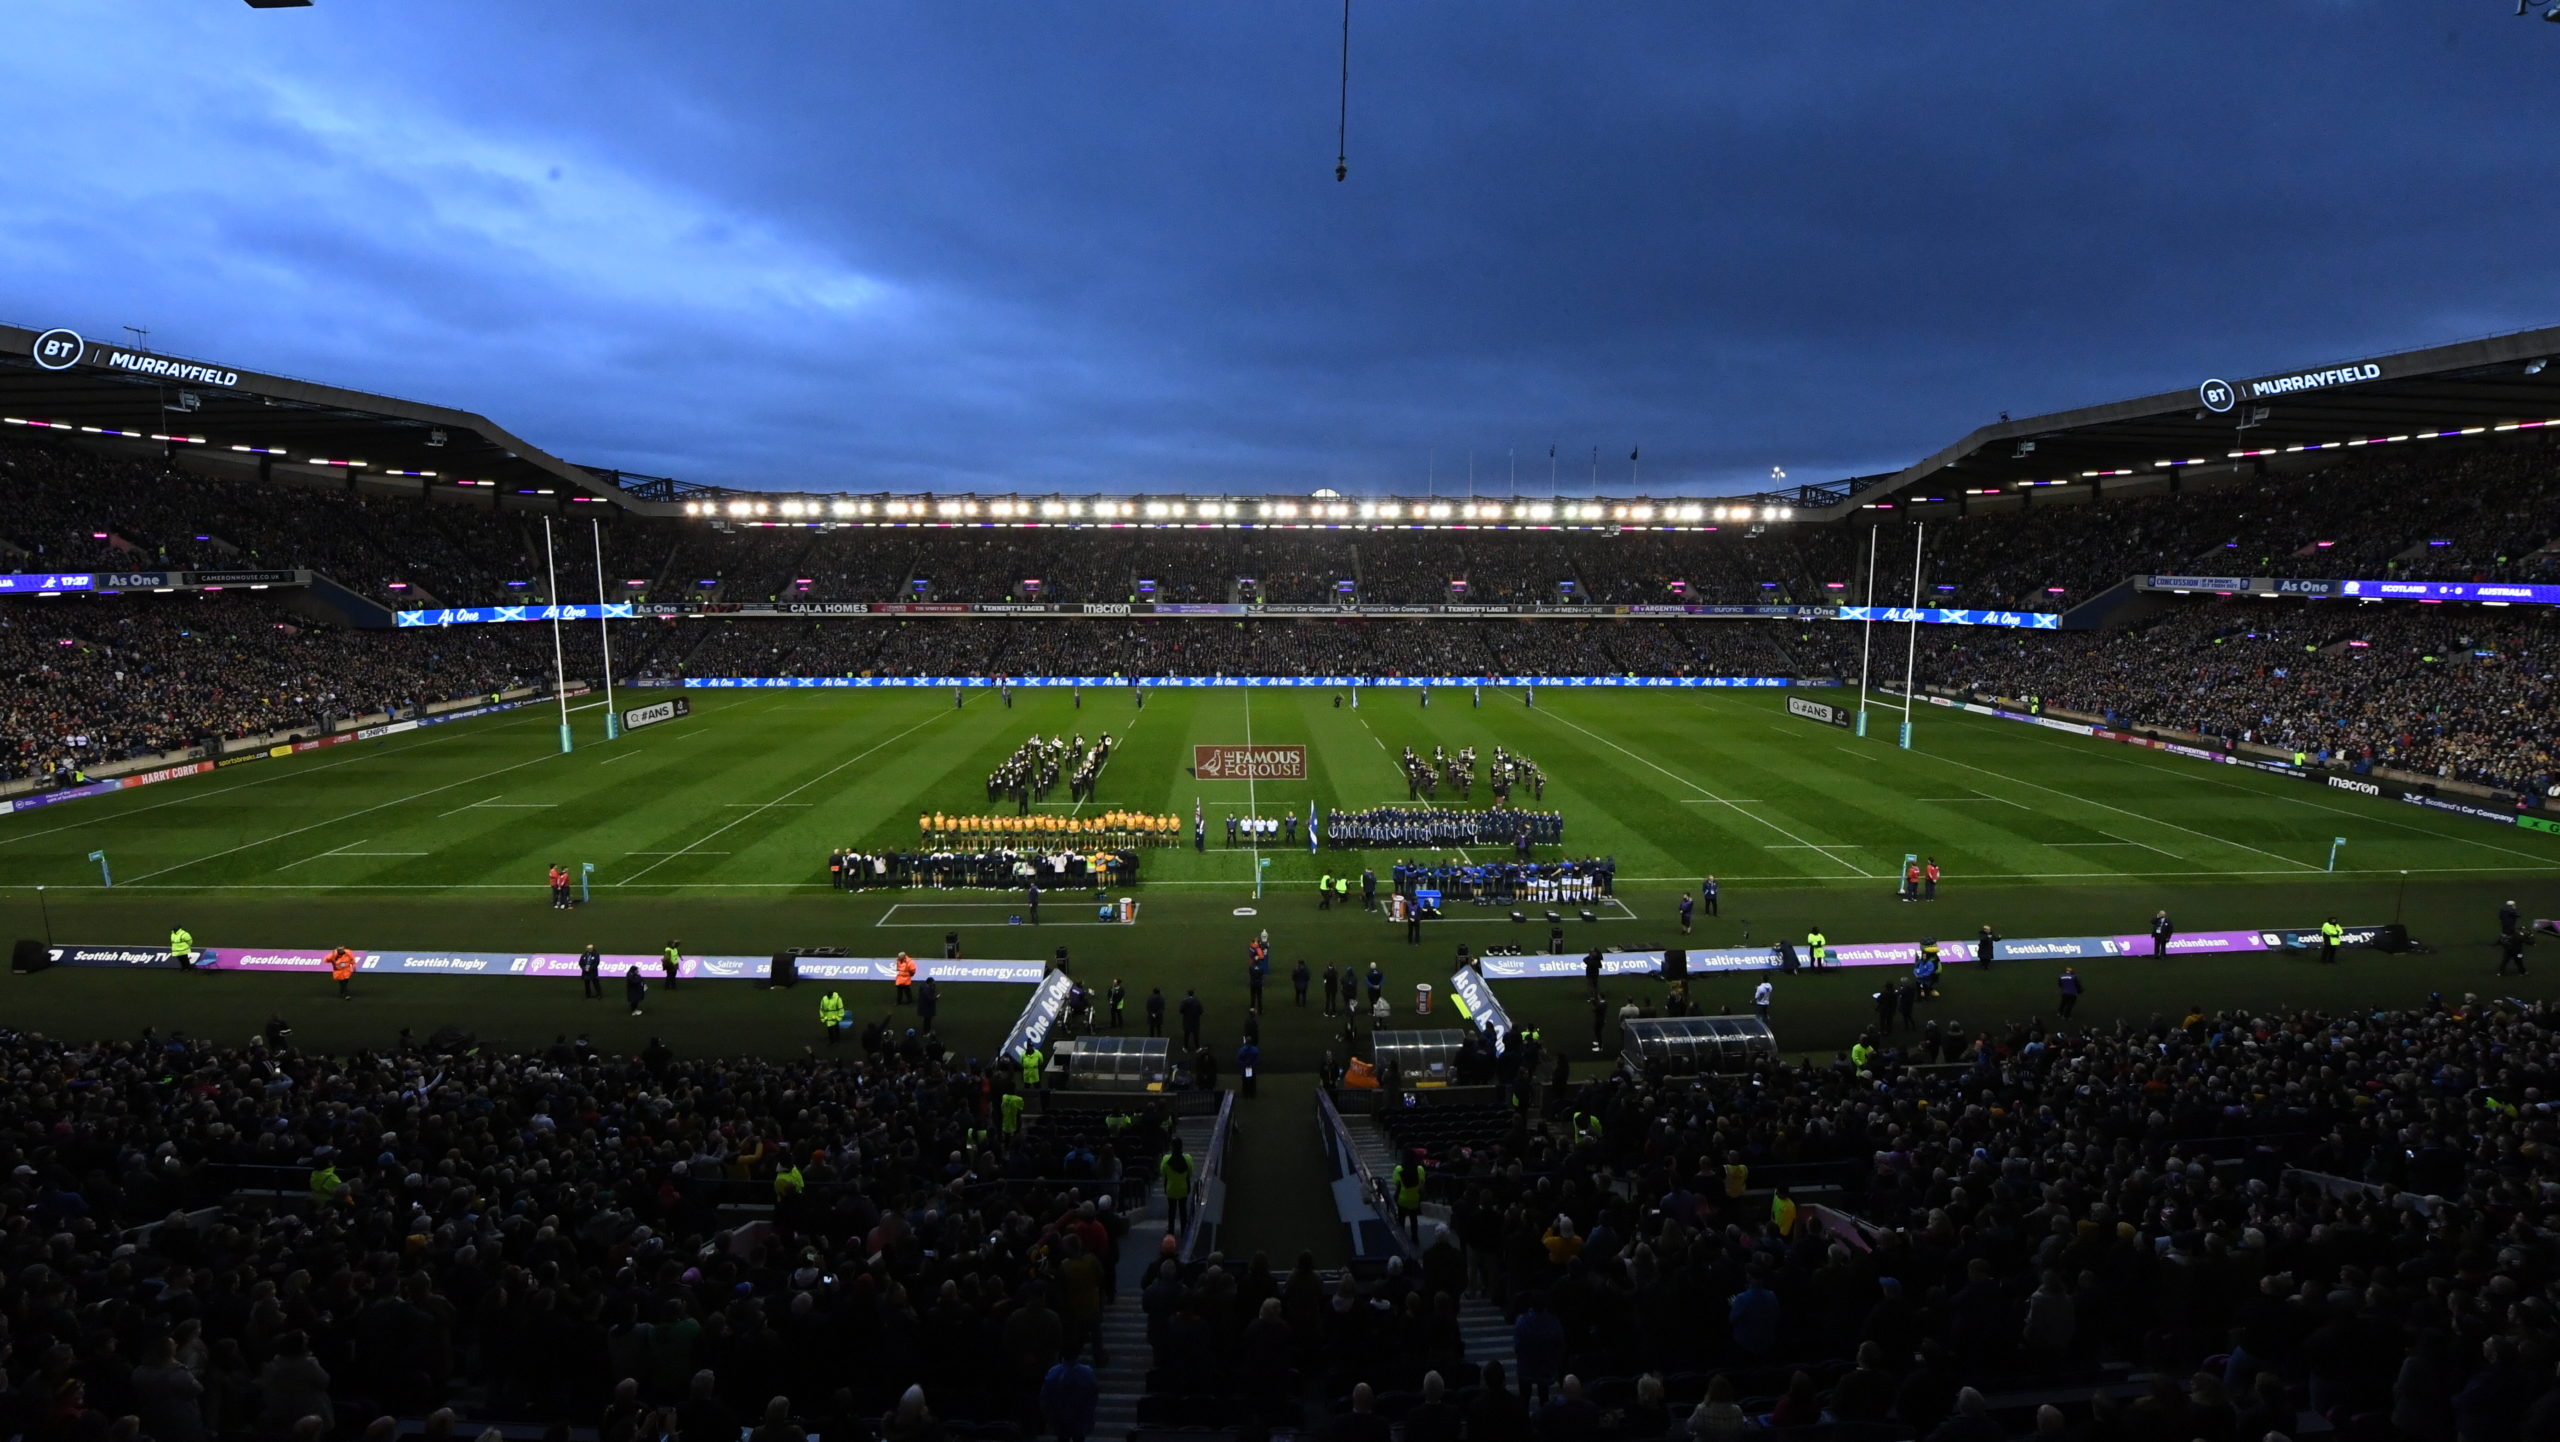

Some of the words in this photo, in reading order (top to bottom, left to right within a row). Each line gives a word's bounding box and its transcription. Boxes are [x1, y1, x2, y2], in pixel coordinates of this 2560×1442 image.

[44, 340, 74, 358] BT
[109, 351, 238, 387] MURRAYFIELD
[2207, 388, 2226, 403] BT
[2252, 363, 2381, 397] MURRAYFIELD
[61, 575, 89, 586] 17:27
[108, 574, 132, 587] As
[133, 573, 160, 586] One
[201, 573, 280, 582] CAMERONHOUSE.CO.UK
[2156, 577, 2199, 588] CONCUSSION
[2281, 580, 2297, 592] As
[2300, 580, 2329, 593] One
[2381, 584, 2427, 594] SCOTLAND
[2477, 587, 2532, 597] AUSTRALIA
[542, 605, 559, 618] As
[562, 604, 586, 618] One
[637, 605, 651, 613] As
[653, 604, 678, 613] One
[790, 604, 822, 613] CALA
[825, 604, 868, 613] HOMES
[982, 604, 1021, 612] TENNENT'S
[1022, 604, 1045, 612] LAGER
[1083, 603, 1131, 614] macron
[1798, 606, 1811, 615] As
[1813, 607, 1836, 616] One
[1883, 607, 1900, 620] As
[1901, 608, 1924, 621] One
[437, 608, 454, 622] As
[456, 608, 479, 622] One
[1982, 610, 1998, 624] As
[2000, 611, 2021, 625] One
[641, 706, 669, 721] #ANS
[1801, 703, 1828, 718] #ANS
[1235, 750, 1300, 764] FAMOUS
[2177, 744, 2209, 757] ARGENTINA
[218, 751, 268, 767] sportsbreaks.com
[1224, 751, 1236, 776] THE
[141, 769, 170, 785] HARRY
[172, 763, 199, 779] CORRY
[1235, 763, 1301, 776] GROUSE
[2328, 775, 2379, 796] macron
[2425, 798, 2461, 811] Scotland's
[2462, 805, 2475, 815] Car
[2477, 808, 2516, 823] Company.
[2338, 932, 2363, 943] ugby
[1836, 950, 1874, 961] cottish
[1874, 948, 1909, 959] Rugby
[2005, 943, 2048, 955] Scottish
[2049, 942, 2081, 954] Rugby
[74, 951, 118, 962] Scottish
[118, 951, 153, 964] Rugby
[154, 952, 172, 963] TV
[240, 954, 322, 966] @scotlandteam
[403, 957, 450, 968] Scottish
[450, 957, 488, 970] Rugby
[717, 959, 744, 968] Saltire
[1497, 959, 1525, 968] Saltire
[929, 963, 1043, 979] saltire-energy.com
[1049, 975, 1071, 998] One
[1453, 970, 1469, 987] As
[1462, 983, 1482, 1012] One
[1041, 996, 1060, 1019] As
[1025, 1015, 1050, 1043] One
